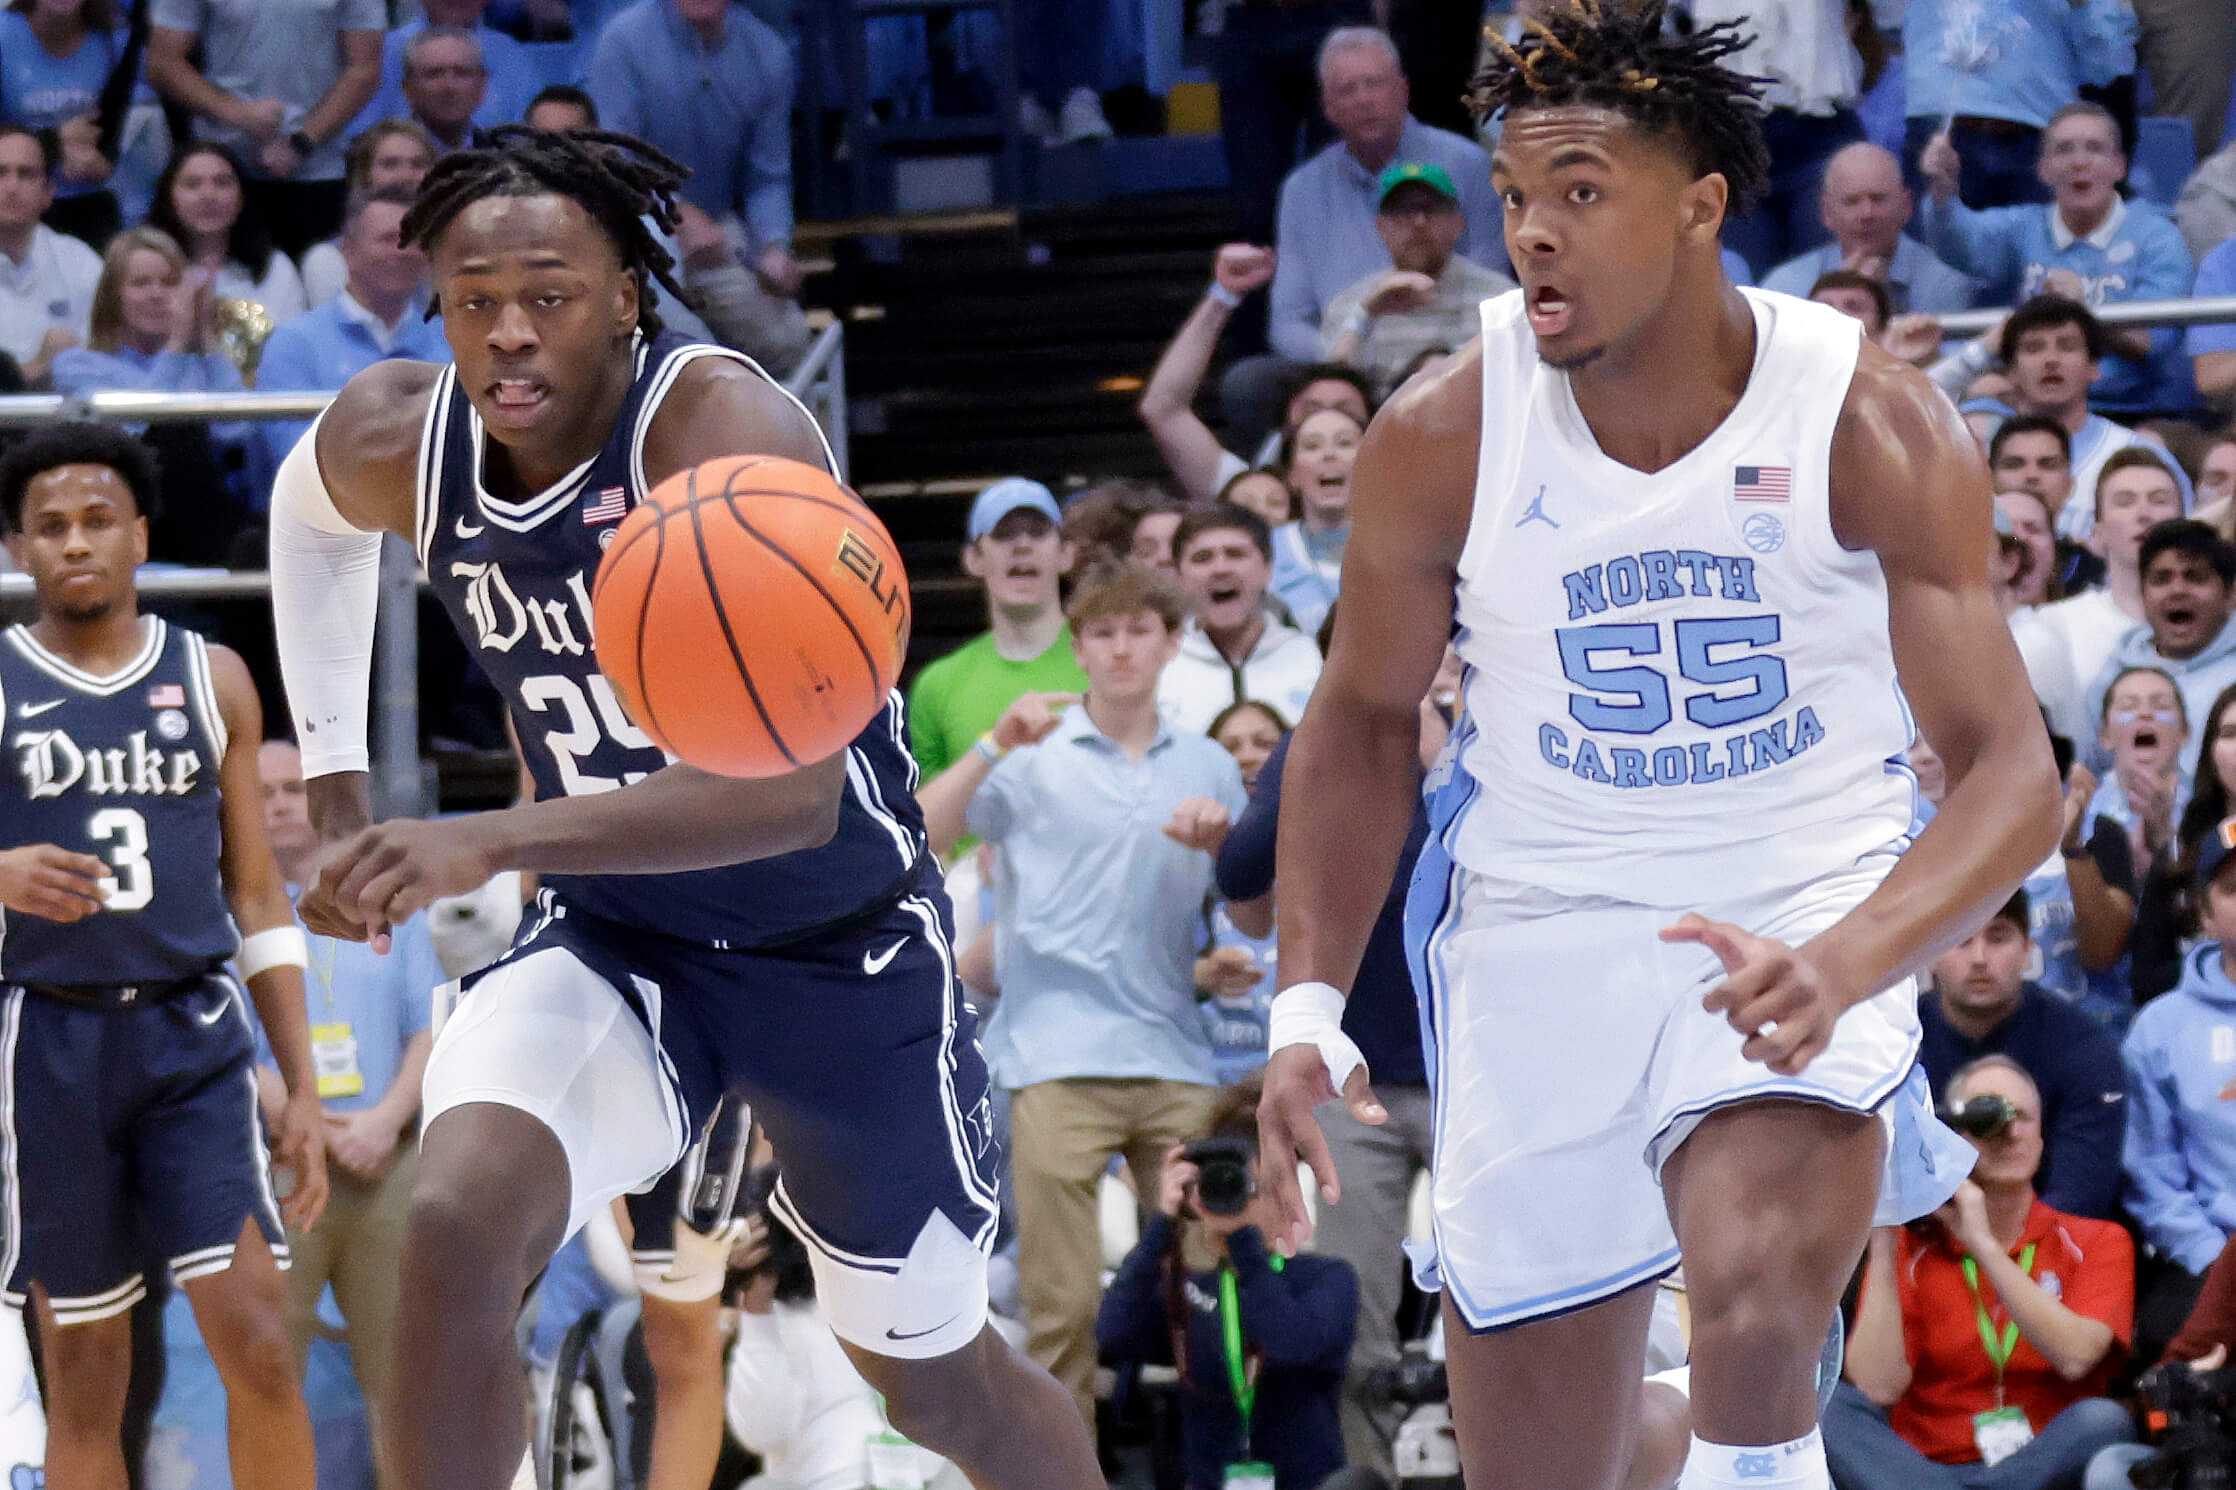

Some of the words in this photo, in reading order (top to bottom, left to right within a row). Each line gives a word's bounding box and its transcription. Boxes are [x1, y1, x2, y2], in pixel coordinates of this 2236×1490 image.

[451, 561, 597, 656] Du
[1562, 549, 1761, 621] NORTH
[1554, 613, 1789, 735] 55
[15, 729, 202, 800] Duke
[1538, 705, 1826, 788] CAROLINA
[89, 807, 154, 911] 3
